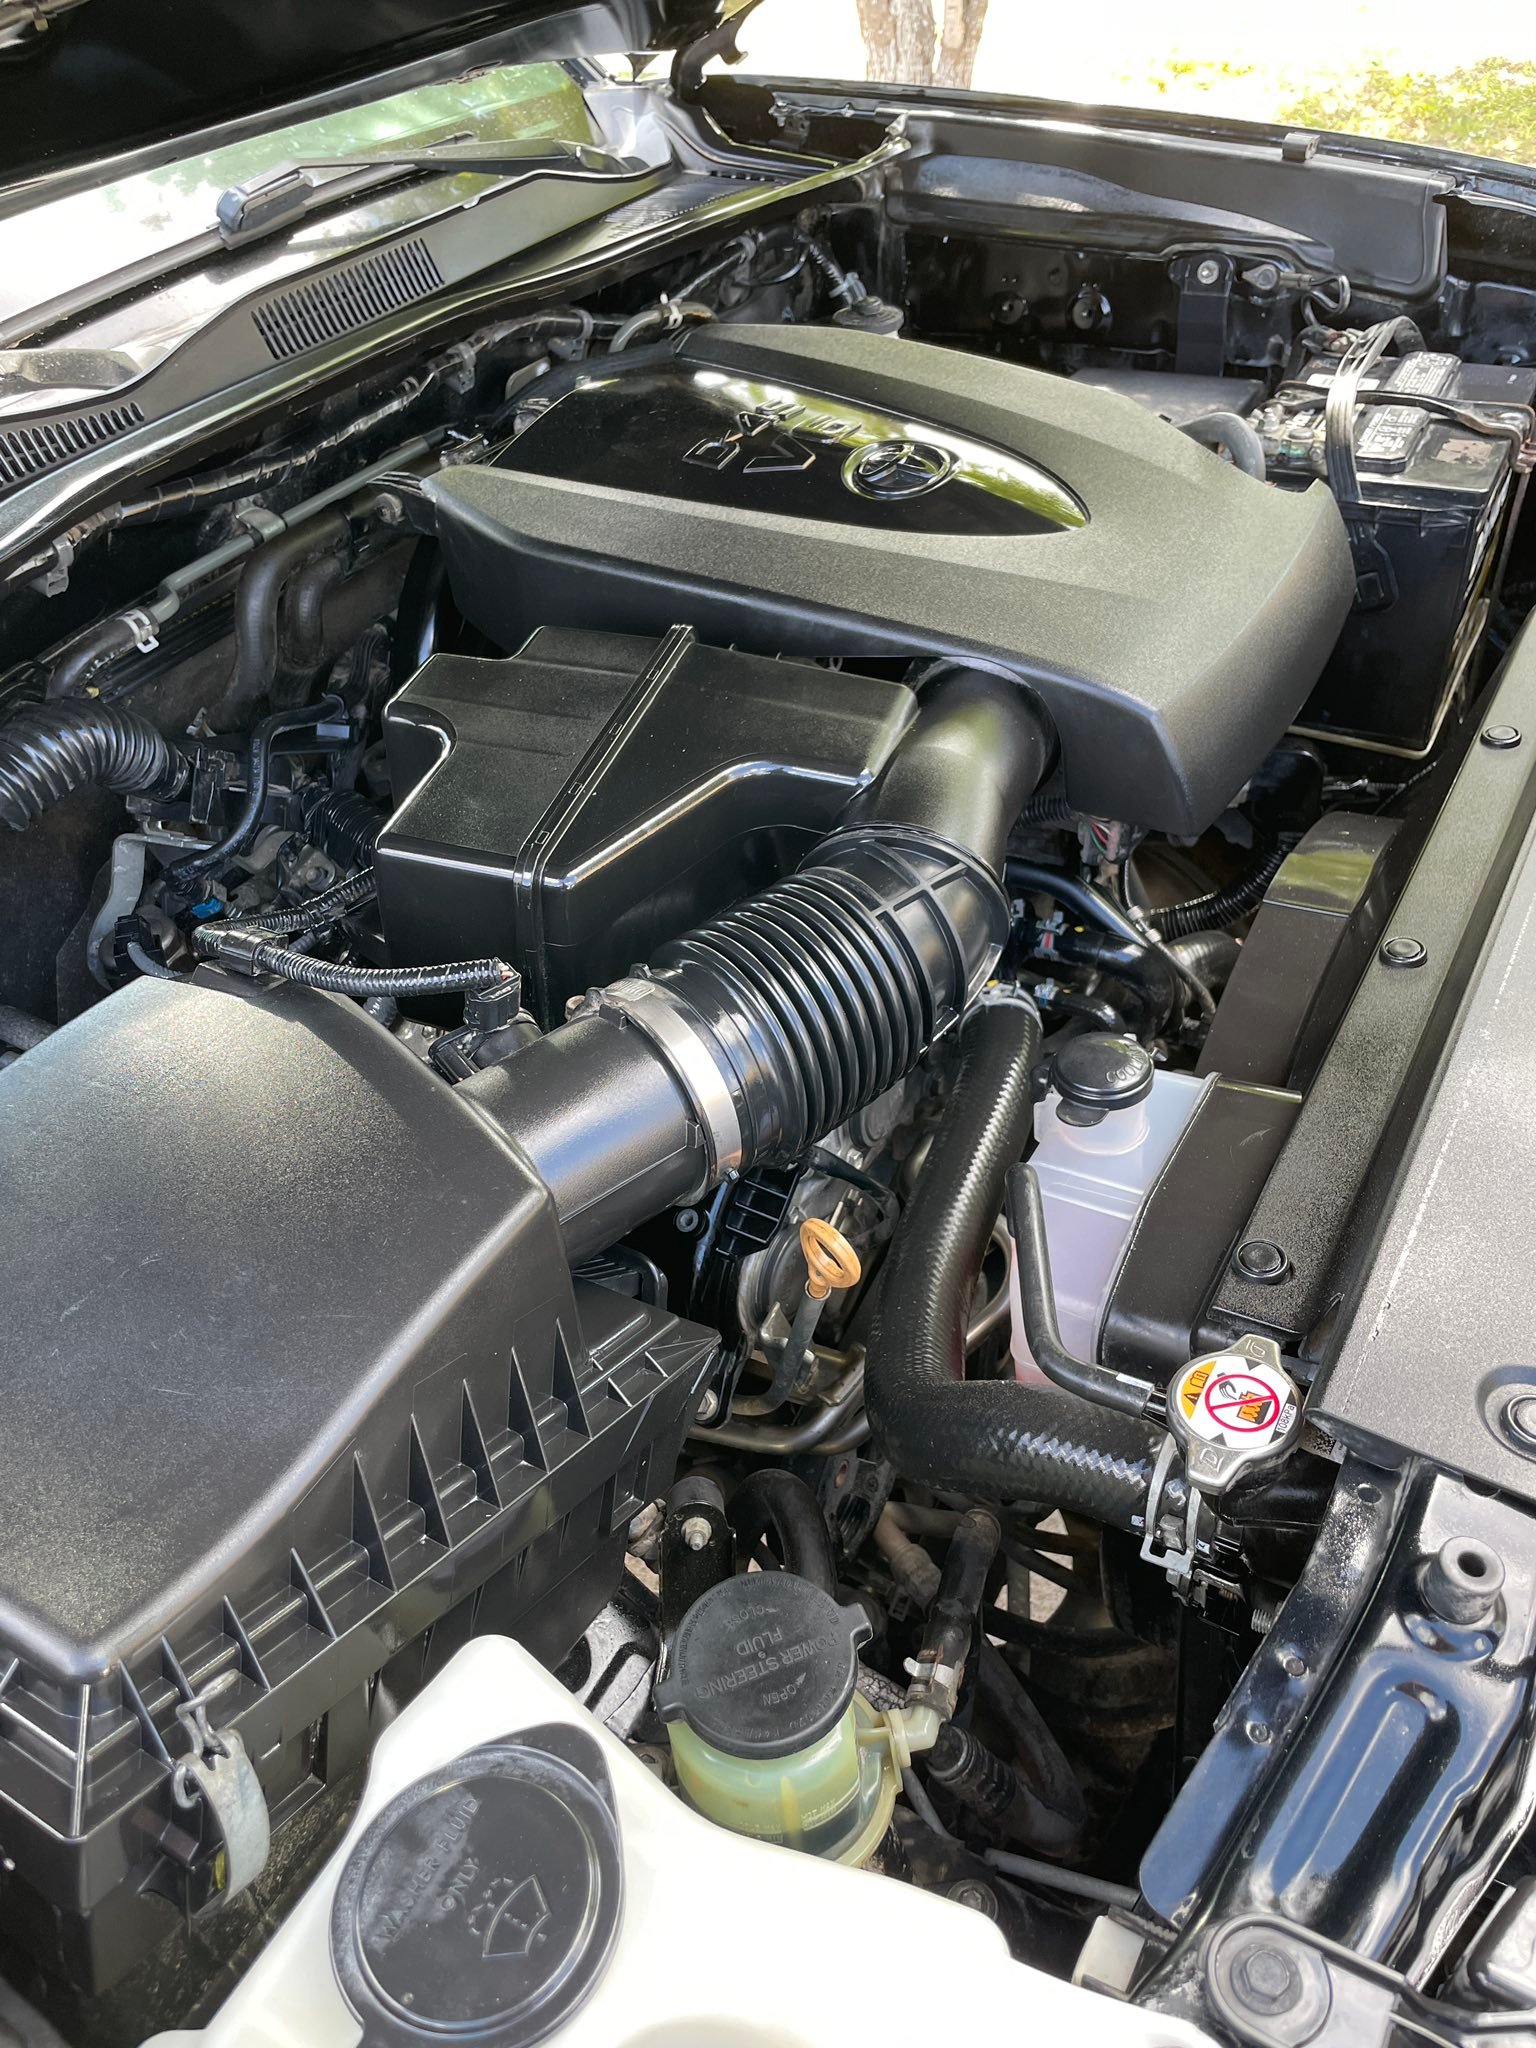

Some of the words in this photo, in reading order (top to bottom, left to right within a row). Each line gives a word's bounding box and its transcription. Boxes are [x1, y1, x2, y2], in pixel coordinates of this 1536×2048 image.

[1276, 1404, 1296, 1433] 108kPa
[736, 1626, 784, 1657] FLUID
[782, 1633, 840, 1666] POWER
[694, 1655, 781, 1699] STEERING
[762, 1685, 798, 1706] OPEN
[378, 1856, 441, 1943] WASHER
[436, 1797, 481, 1852] FLUID
[440, 1857, 480, 1912] ONLY
